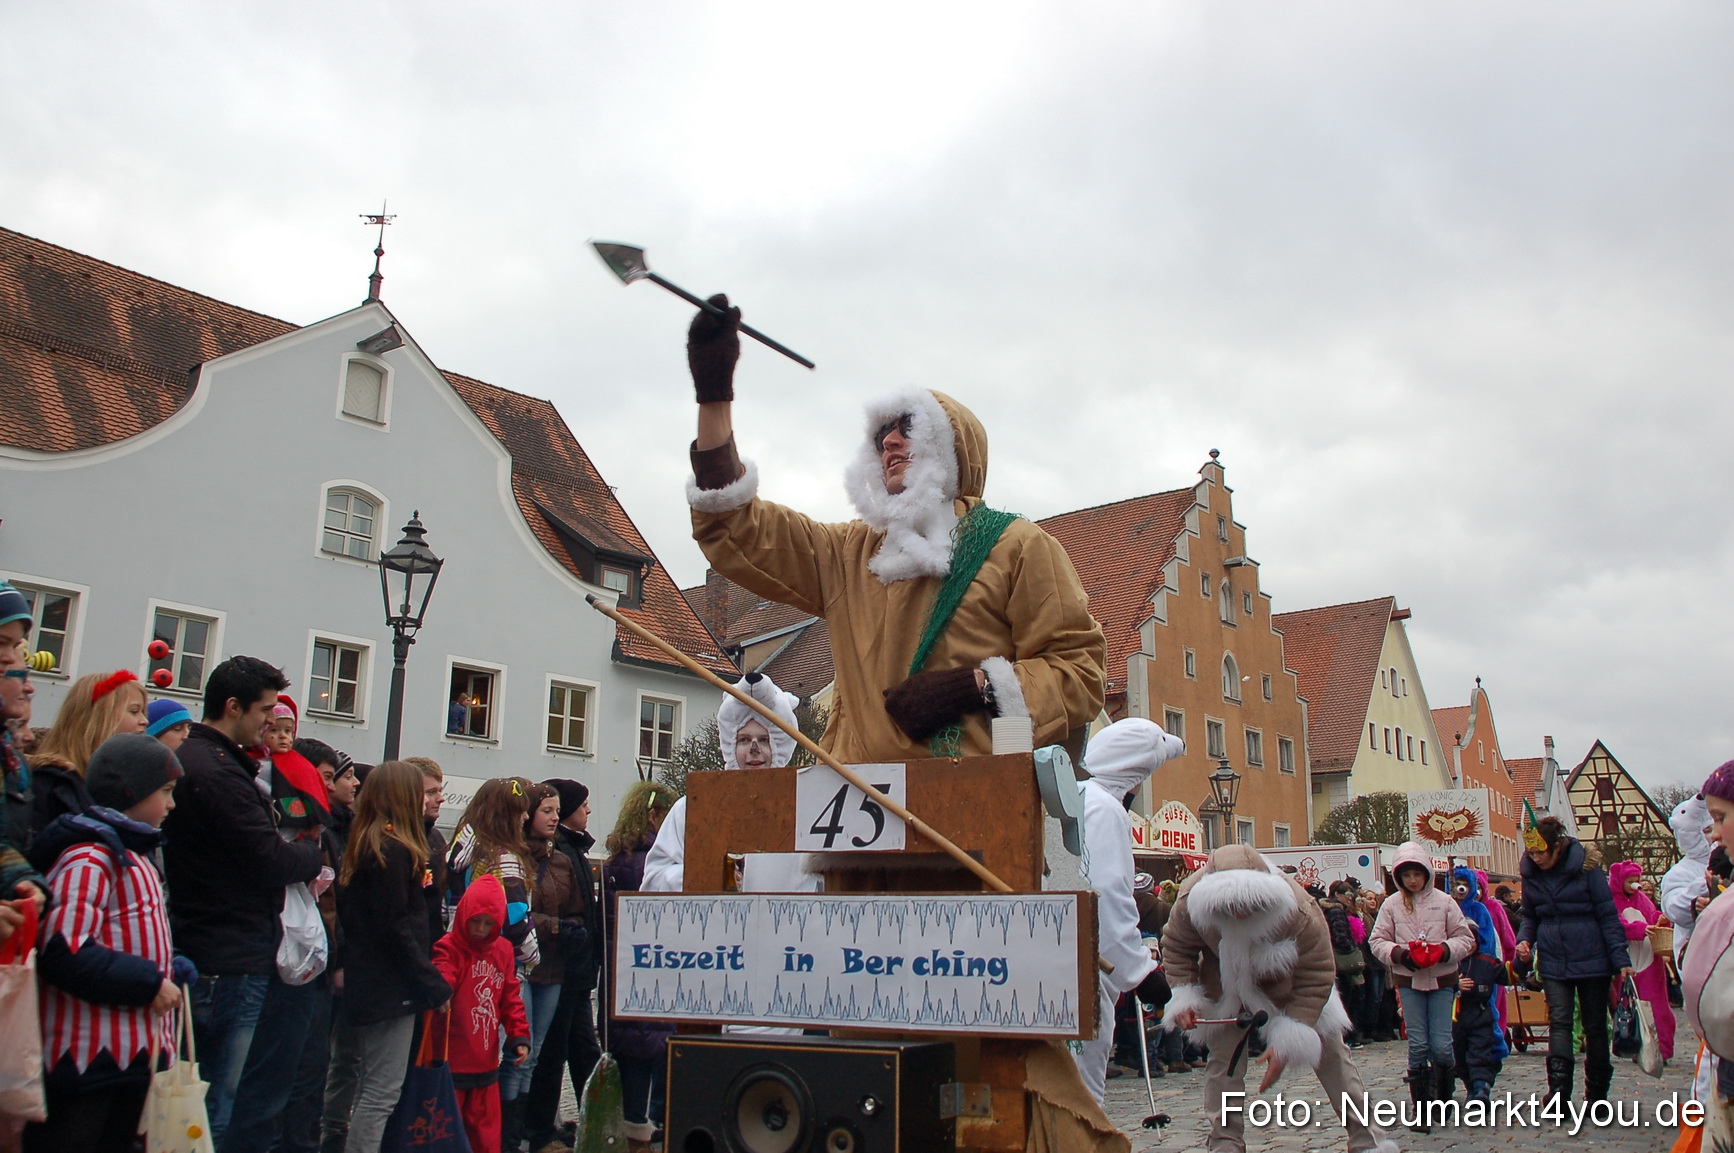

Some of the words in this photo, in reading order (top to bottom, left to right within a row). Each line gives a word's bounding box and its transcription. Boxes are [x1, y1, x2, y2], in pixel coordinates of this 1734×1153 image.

[810, 783, 891, 848] 45
[1162, 829, 1195, 850] BIENE
[631, 944, 744, 970] Eiszeit
[783, 946, 814, 972] in
